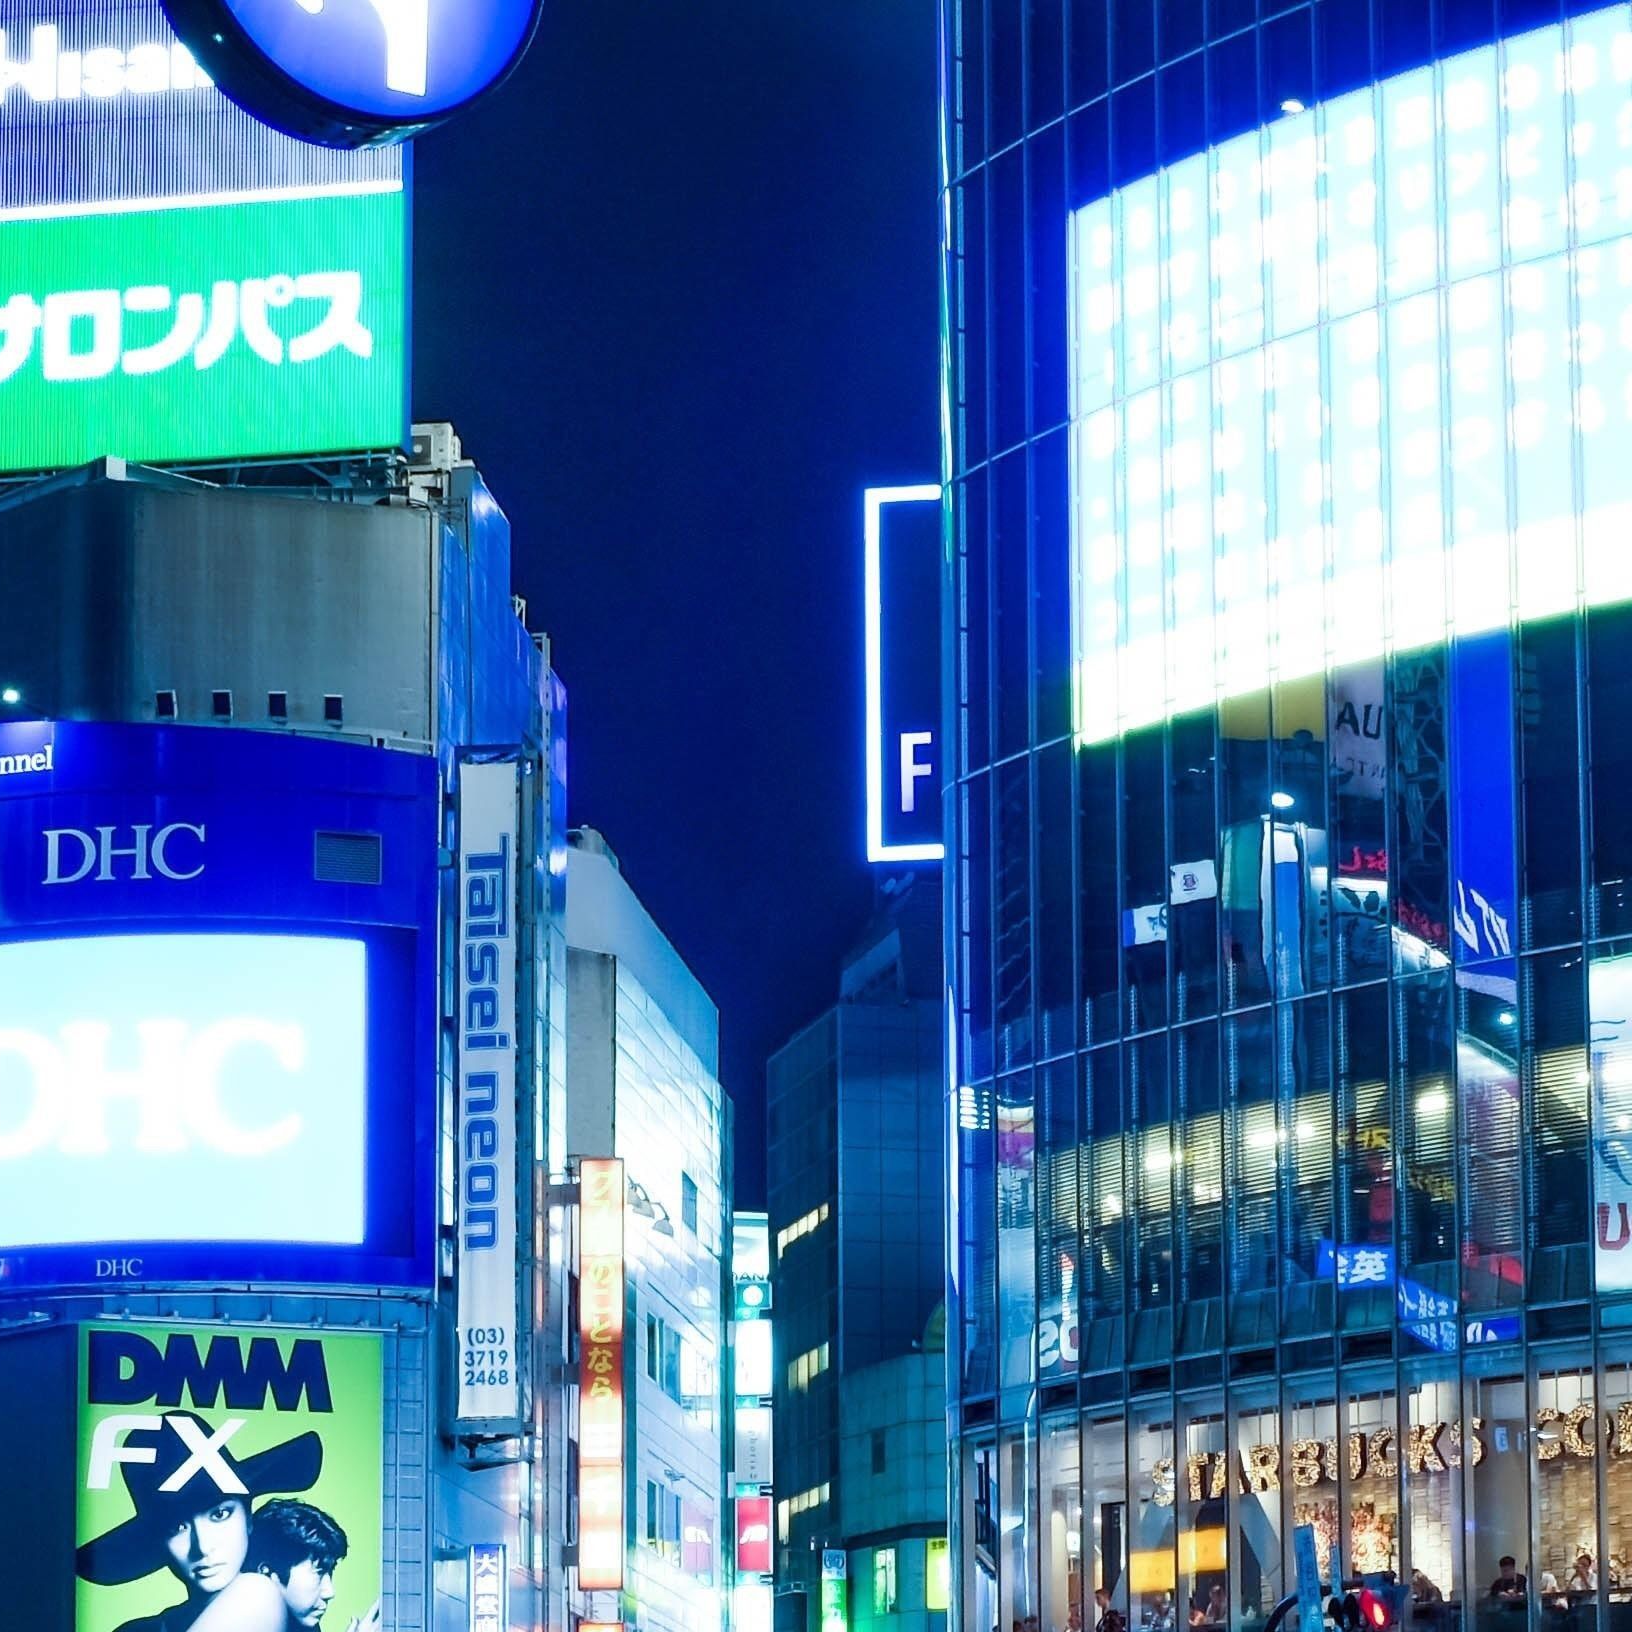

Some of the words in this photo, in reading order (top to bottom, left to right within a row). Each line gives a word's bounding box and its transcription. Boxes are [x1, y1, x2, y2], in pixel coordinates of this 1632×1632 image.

[42, 823, 206, 885] DHC
[464, 831, 510, 1052] Taisei
[464, 1070, 497, 1252] neon
[95, 1257, 143, 1279] DHC
[87, 1331, 333, 1413] DMM
[464, 1349, 509, 1367] 3719
[467, 1325, 505, 1348] (03)
[464, 1368, 509, 1387] 2468
[86, 1414, 251, 1494] FX
[1152, 1416, 1486, 1506] STARBUCKS
